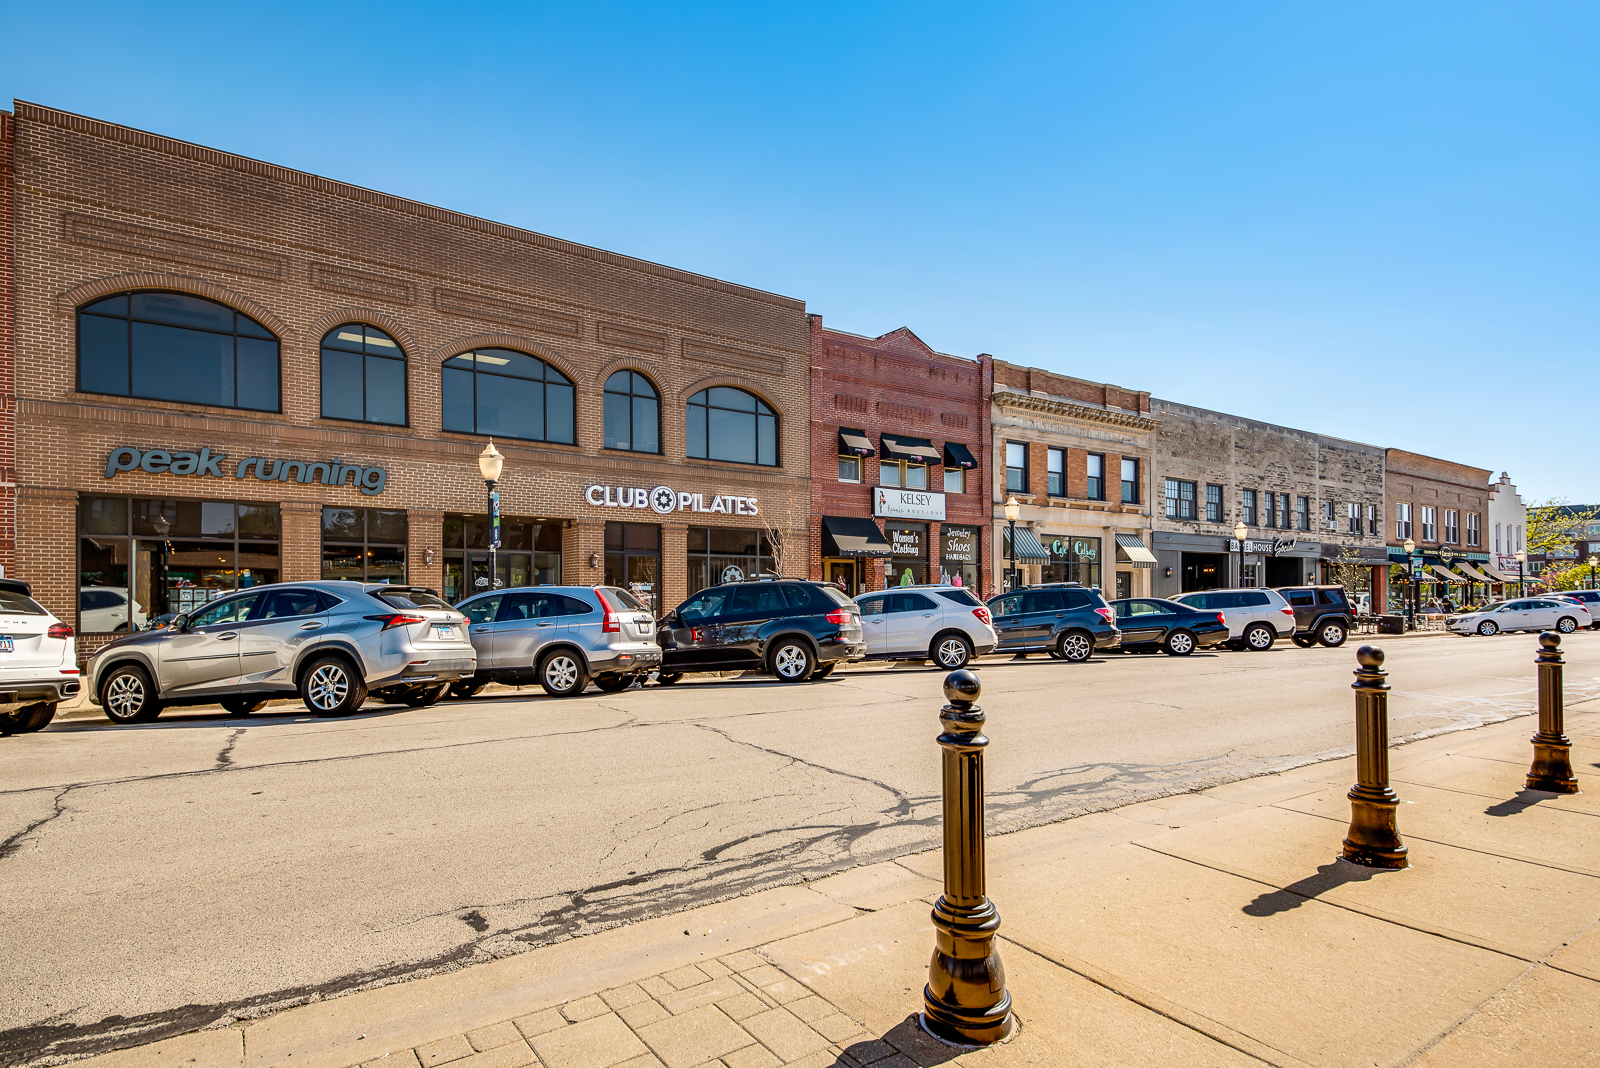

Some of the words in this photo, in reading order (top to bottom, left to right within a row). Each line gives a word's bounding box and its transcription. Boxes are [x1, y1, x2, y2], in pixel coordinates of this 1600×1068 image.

[104, 447, 228, 478] peak
[235, 458, 387, 496] running
[585, 485, 648, 509] CLUB
[677, 492, 759, 516] PILATES
[900, 492, 932, 506] KELSEY
[892, 530, 919, 544] Women's
[947, 528, 971, 539] Jewelry
[892, 543, 919, 556] Clothing
[947, 538, 971, 552] Shoes
[1231, 541, 1252, 551] BAEL
[1253, 543, 1273, 552] HOUSE
[1274, 537, 1297, 557] Social
[946, 553, 972, 561] HANDBAGS
